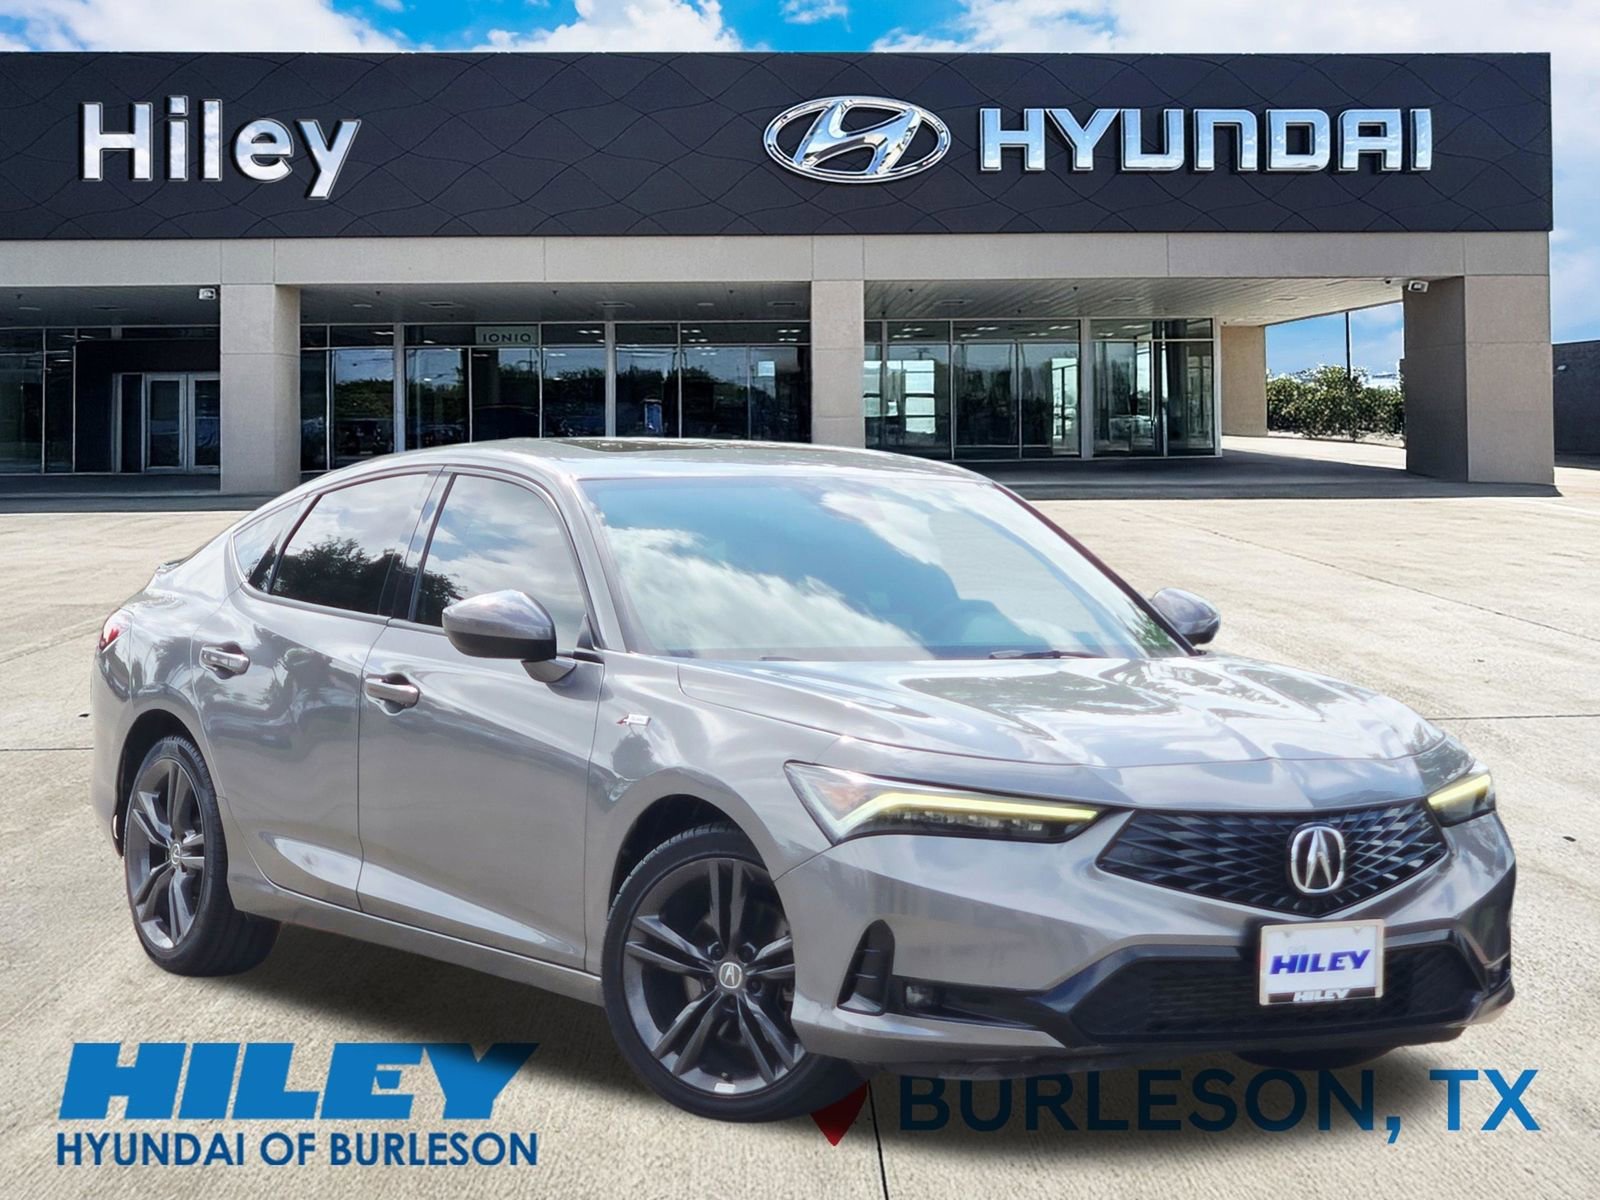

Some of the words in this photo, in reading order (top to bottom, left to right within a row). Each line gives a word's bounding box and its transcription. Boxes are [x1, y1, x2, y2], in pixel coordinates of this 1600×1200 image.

[80, 95, 362, 199] Hiley
[979, 107, 1434, 173] HYUNDAI
[1269, 949, 1371, 975] HILEY
[1293, 988, 1350, 1001] HILEY
